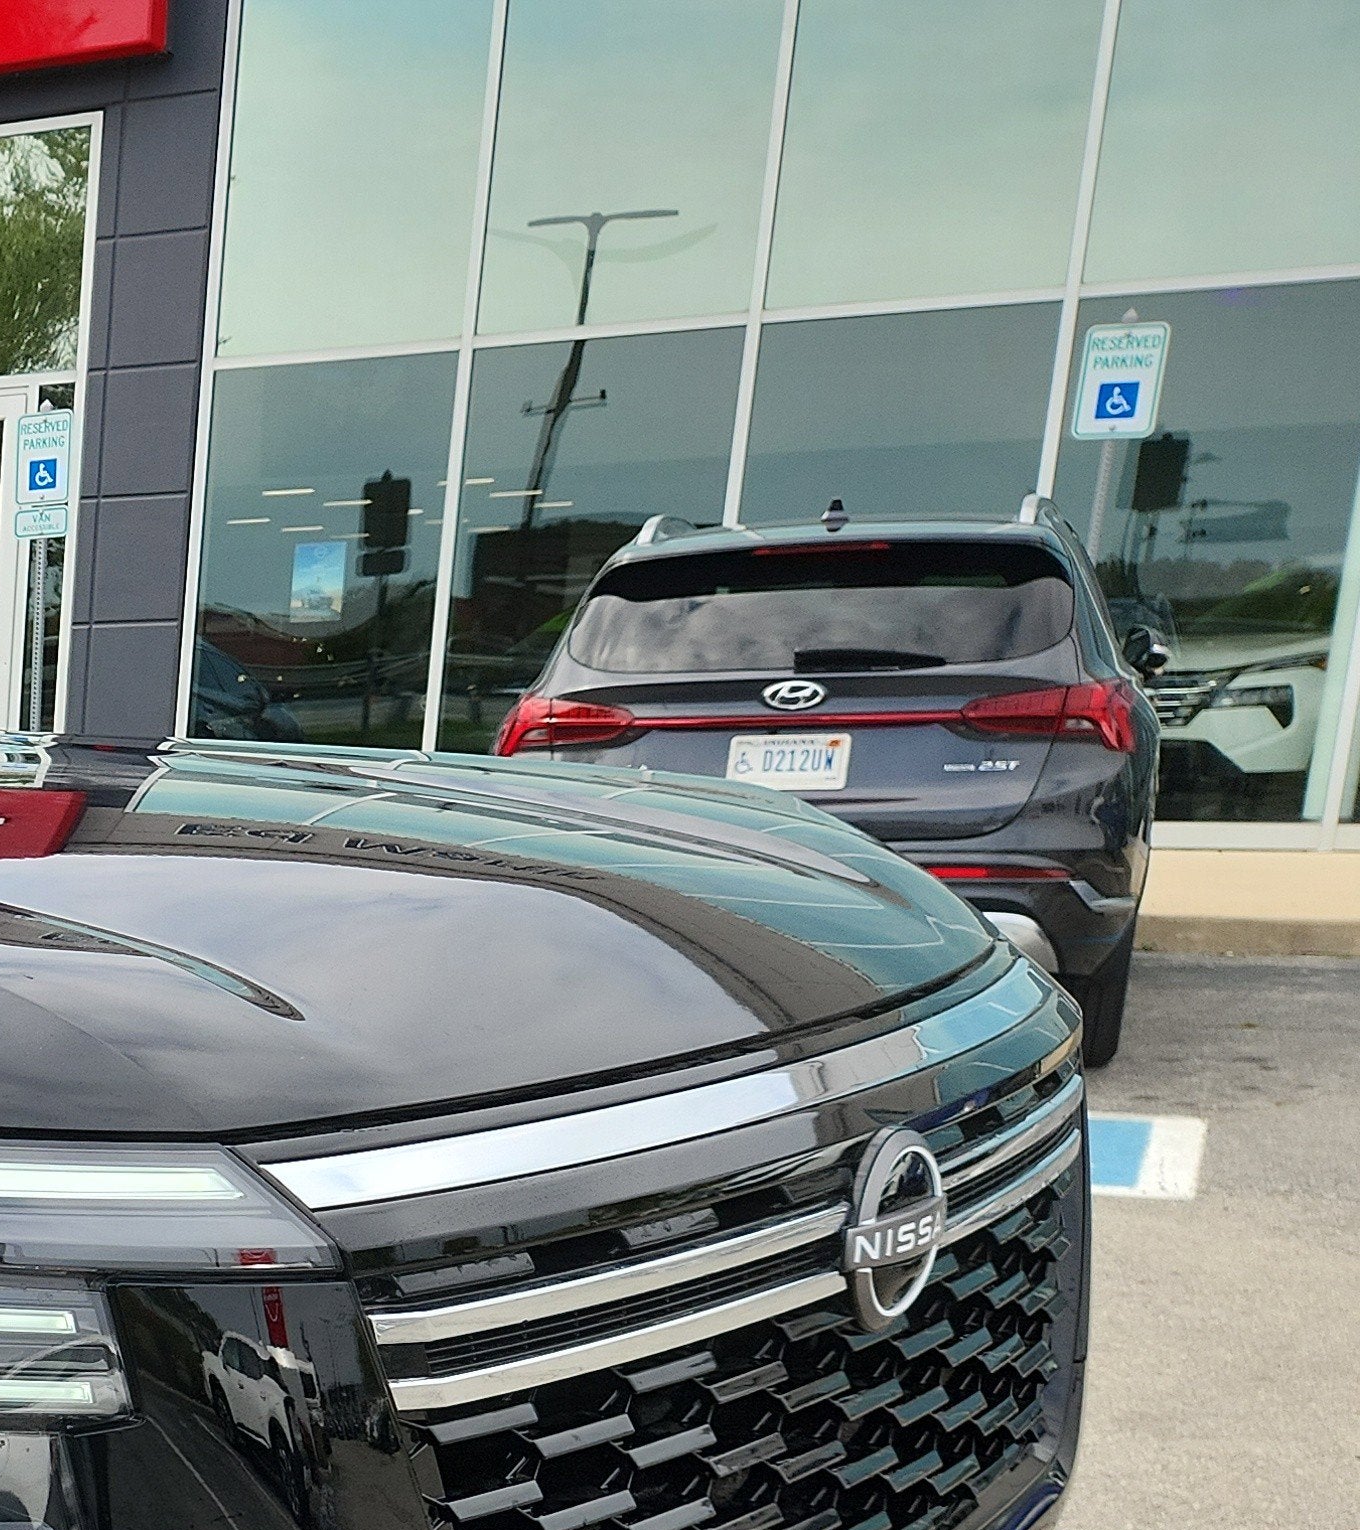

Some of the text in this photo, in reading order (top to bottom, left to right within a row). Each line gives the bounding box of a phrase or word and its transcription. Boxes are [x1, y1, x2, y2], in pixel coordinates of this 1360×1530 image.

[1091, 332, 1162, 351] RESERVED
[1092, 352, 1154, 370] PARKING
[20, 420, 68, 436] RESERVED
[23, 436, 65, 450] PARKING
[32, 513, 51, 522] VAN
[853, 1209, 943, 1264] NISSA
